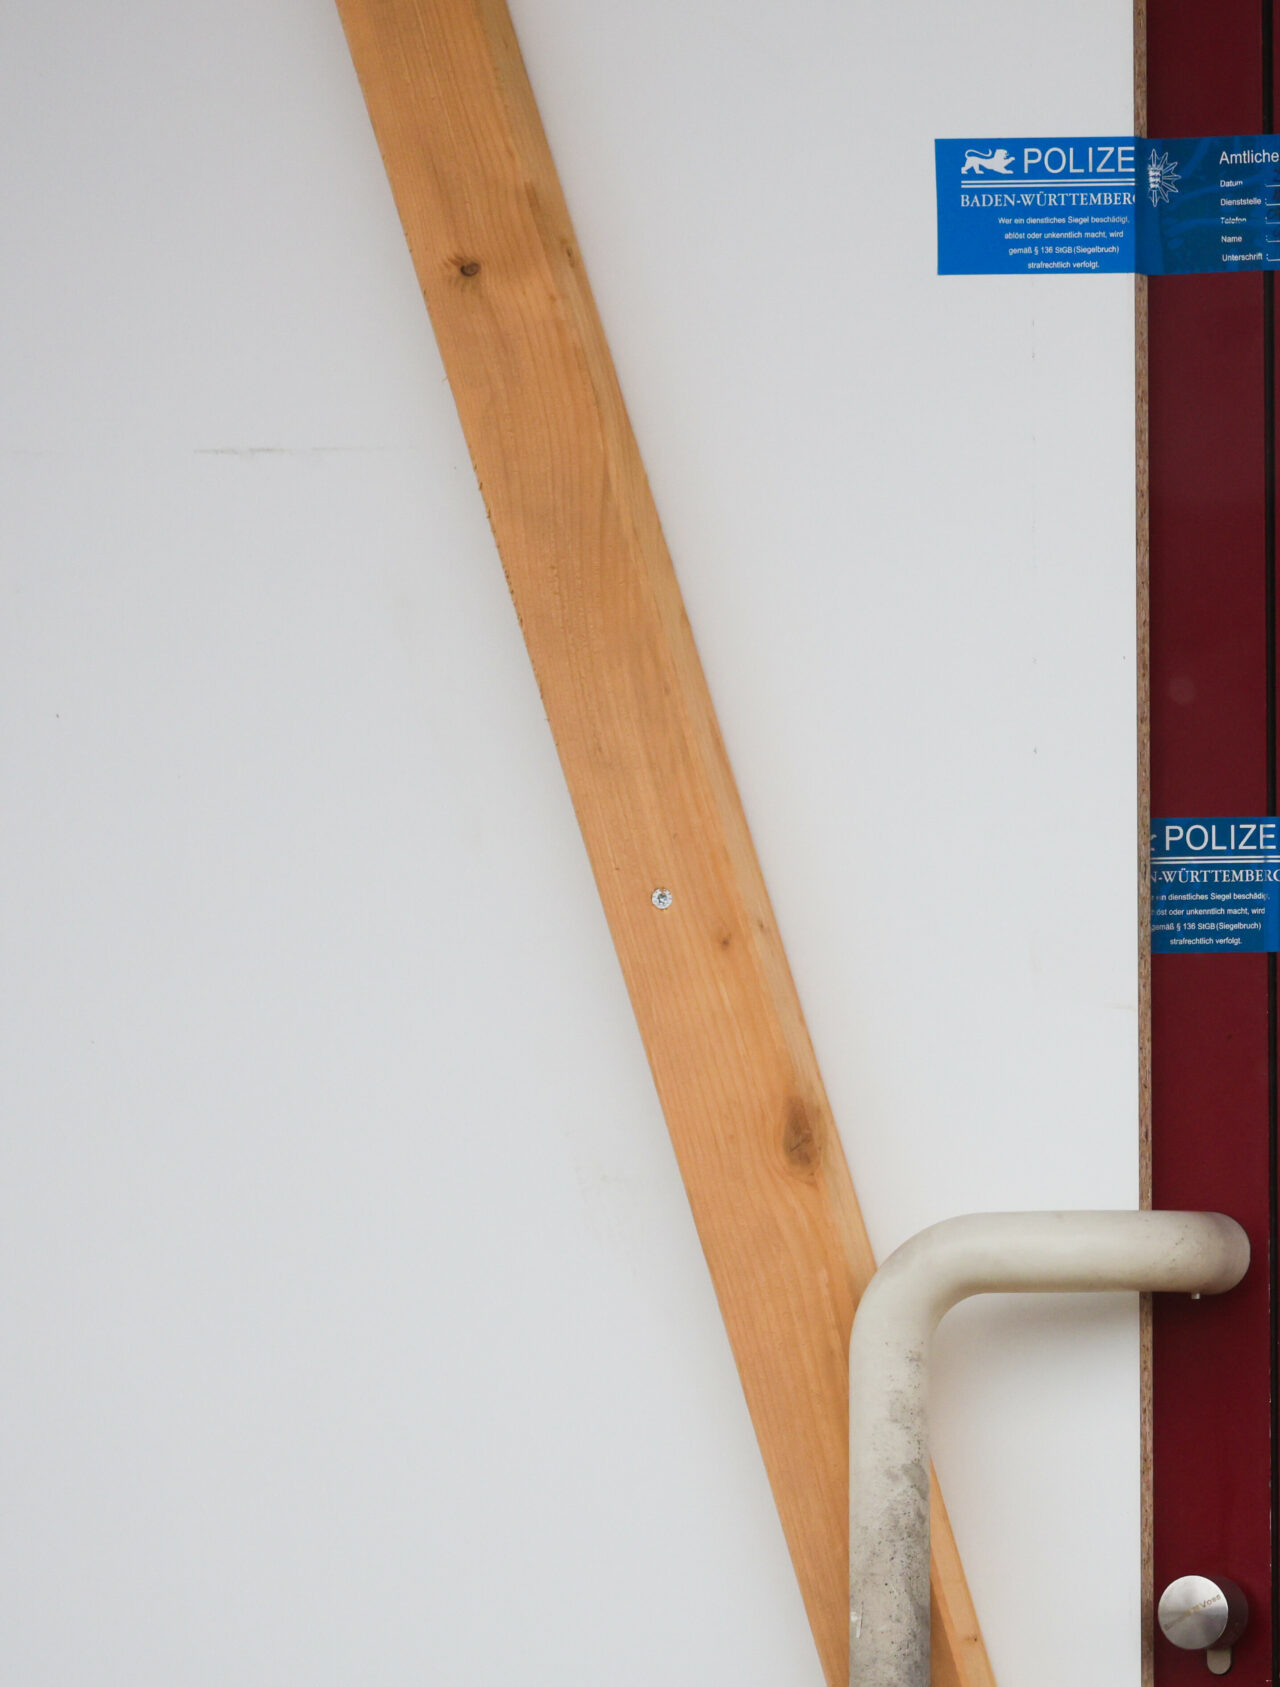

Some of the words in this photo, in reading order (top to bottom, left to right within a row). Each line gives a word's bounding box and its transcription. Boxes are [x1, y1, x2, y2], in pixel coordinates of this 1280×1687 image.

[1219, 180, 1244, 188] Datum
[1220, 197, 1262, 206] Dienststelle
[998, 217, 1013, 225] Wer
[1014, 217, 1025, 225] ein
[1026, 216, 1066, 225] dienstliches
[1067, 216, 1090, 225] Siegel
[1004, 231, 1026, 240] ablöst
[1027, 231, 1043, 239] oder
[1044, 230, 1083, 239] unkenntlich
[1084, 230, 1108, 239] macht,
[1109, 230, 1124, 238] wird
[1221, 235, 1243, 244] Name
[1008, 246, 1033, 256] gemäß
[1034, 246, 1040, 256] §
[1041, 246, 1053, 254] 136
[1055, 246, 1073, 254] StGB
[1073, 245, 1120, 255] (Siegelbruch)
[1221, 252, 1263, 262] Unterschrift
[1027, 260, 1071, 270] strafrechtlich
[1072, 260, 1100, 270] verfolgt.
[1168, 893, 1208, 901] dienstliches
[1210, 892, 1232, 902] Siegel
[1168, 908, 1184, 916] oder
[1186, 907, 1225, 916] unkenntlich
[1226, 907, 1250, 916] macht,
[1251, 907, 1266, 915] wird
[1176, 922, 1182, 932] §
[1183, 922, 1196, 931] 136
[1197, 922, 1215, 931] StGB
[1216, 921, 1262, 932] (Siegelbruch)
[1169, 936, 1214, 946] strafrechtlich
[1215, 936, 1243, 947] verfolgt.
